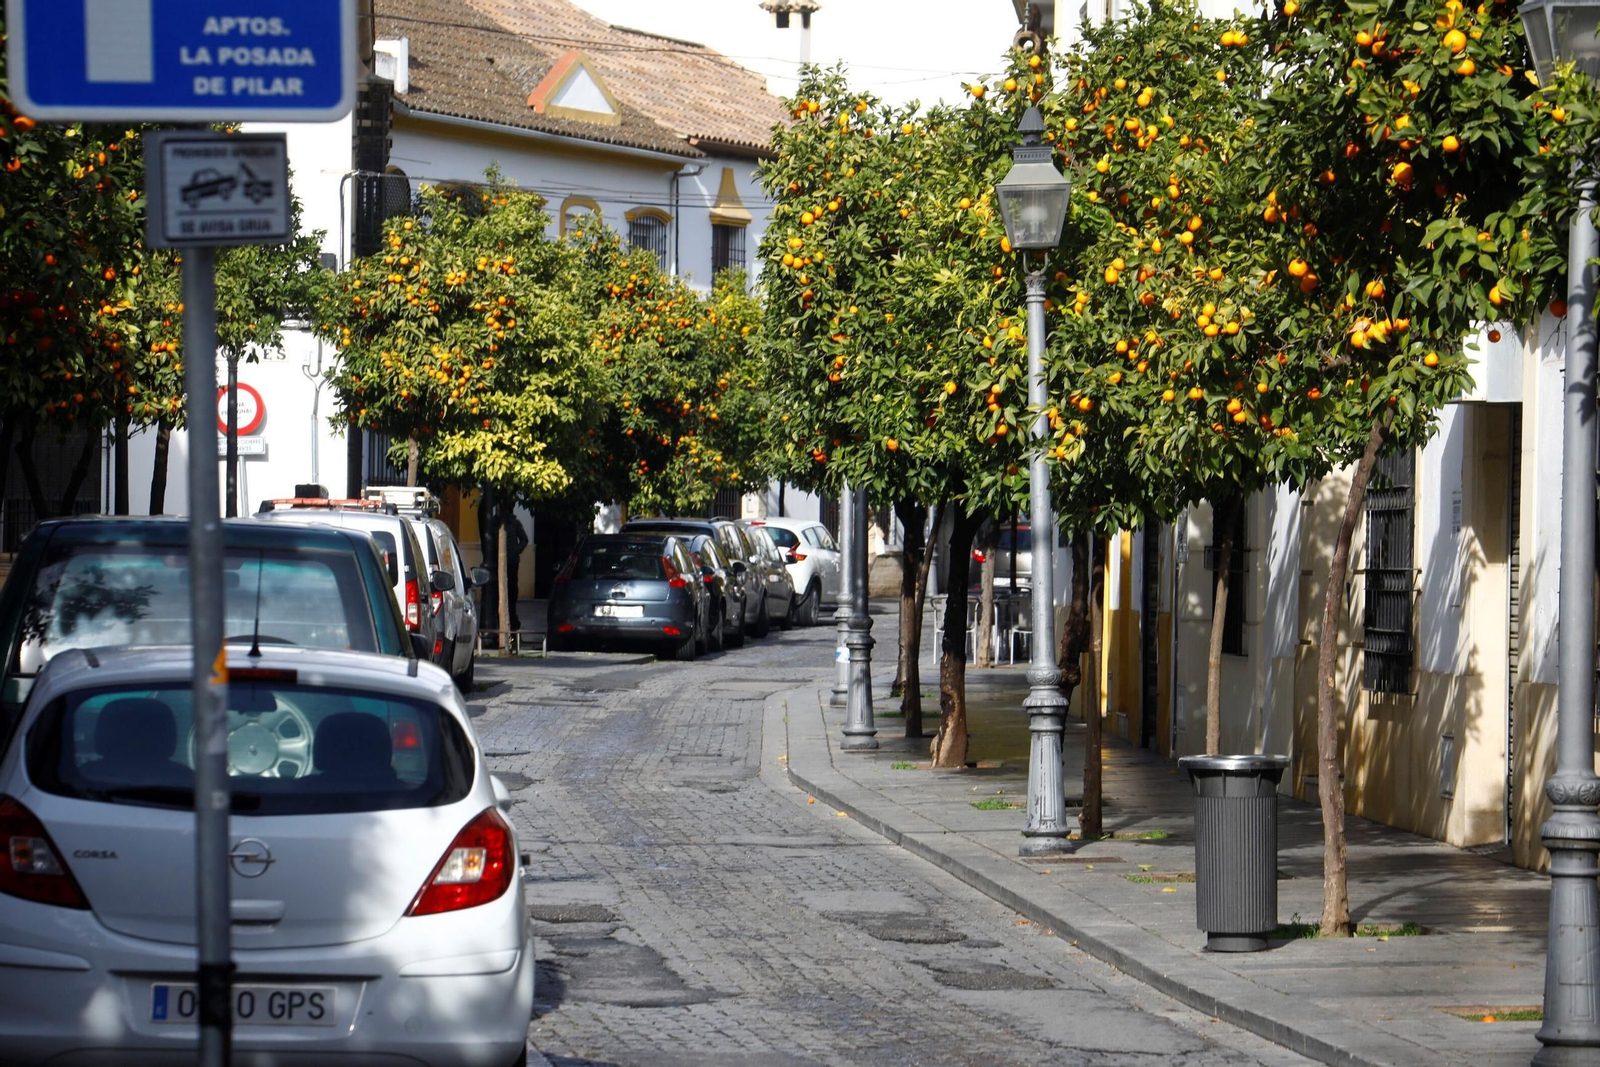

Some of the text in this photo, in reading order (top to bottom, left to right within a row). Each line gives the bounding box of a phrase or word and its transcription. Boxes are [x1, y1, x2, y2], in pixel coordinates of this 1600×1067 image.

[203, 16, 290, 36] APTOS.
[180, 47, 315, 66] LA POSADA
[193, 77, 304, 96] DE PILAR
[73, 849, 118, 860] CORSA
[178, 989, 325, 1020] 00 GPS
